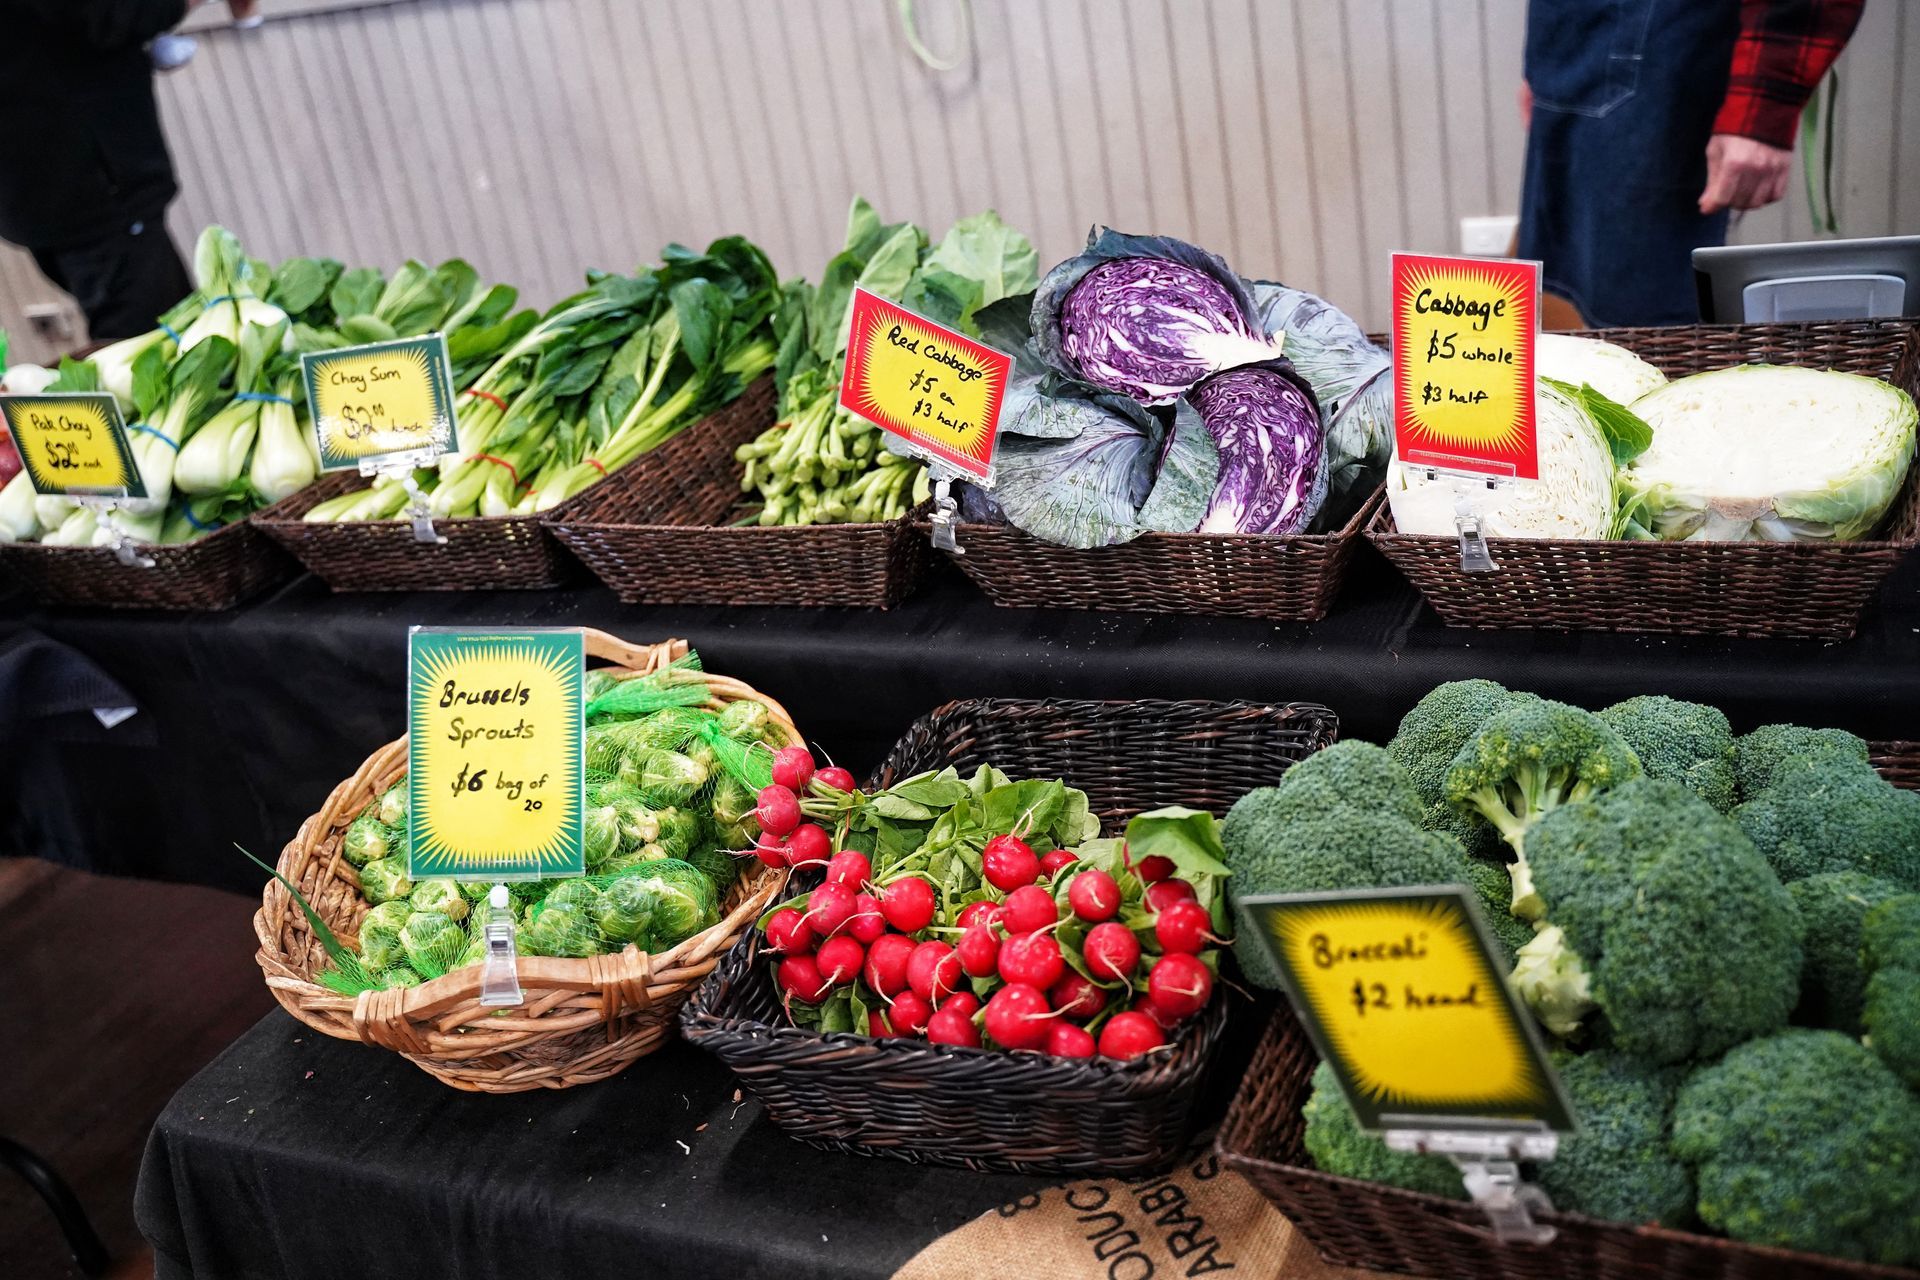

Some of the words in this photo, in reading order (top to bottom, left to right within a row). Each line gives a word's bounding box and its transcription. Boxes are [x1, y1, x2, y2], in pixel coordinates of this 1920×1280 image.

[1415, 288, 1506, 331] Cabbage
[887, 325, 920, 354] Red
[924, 345, 982, 382] Cabbage
[1427, 329, 1458, 363] $5
[1462, 348, 1513, 365] whole
[370, 366, 401, 382] Sum
[909, 369, 938, 393] $5
[940, 392, 955, 406] ea
[1422, 382, 1442, 405] $3
[1450, 389, 1488, 405] half
[31, 413, 57, 431] Pak
[913, 398, 932, 417] $3
[937, 411, 968, 433] half
[440, 680, 530, 708] Brussels
[448, 717, 535, 748] Sprouts
[452, 763, 487, 797] $6
[495, 771, 523, 800] bag
[529, 774, 549, 790] of
[524, 799, 543, 812] 20
[1309, 931, 1428, 969] Broccoli
[1353, 979, 1392, 1018] $2
[1405, 984, 1484, 1010] head
